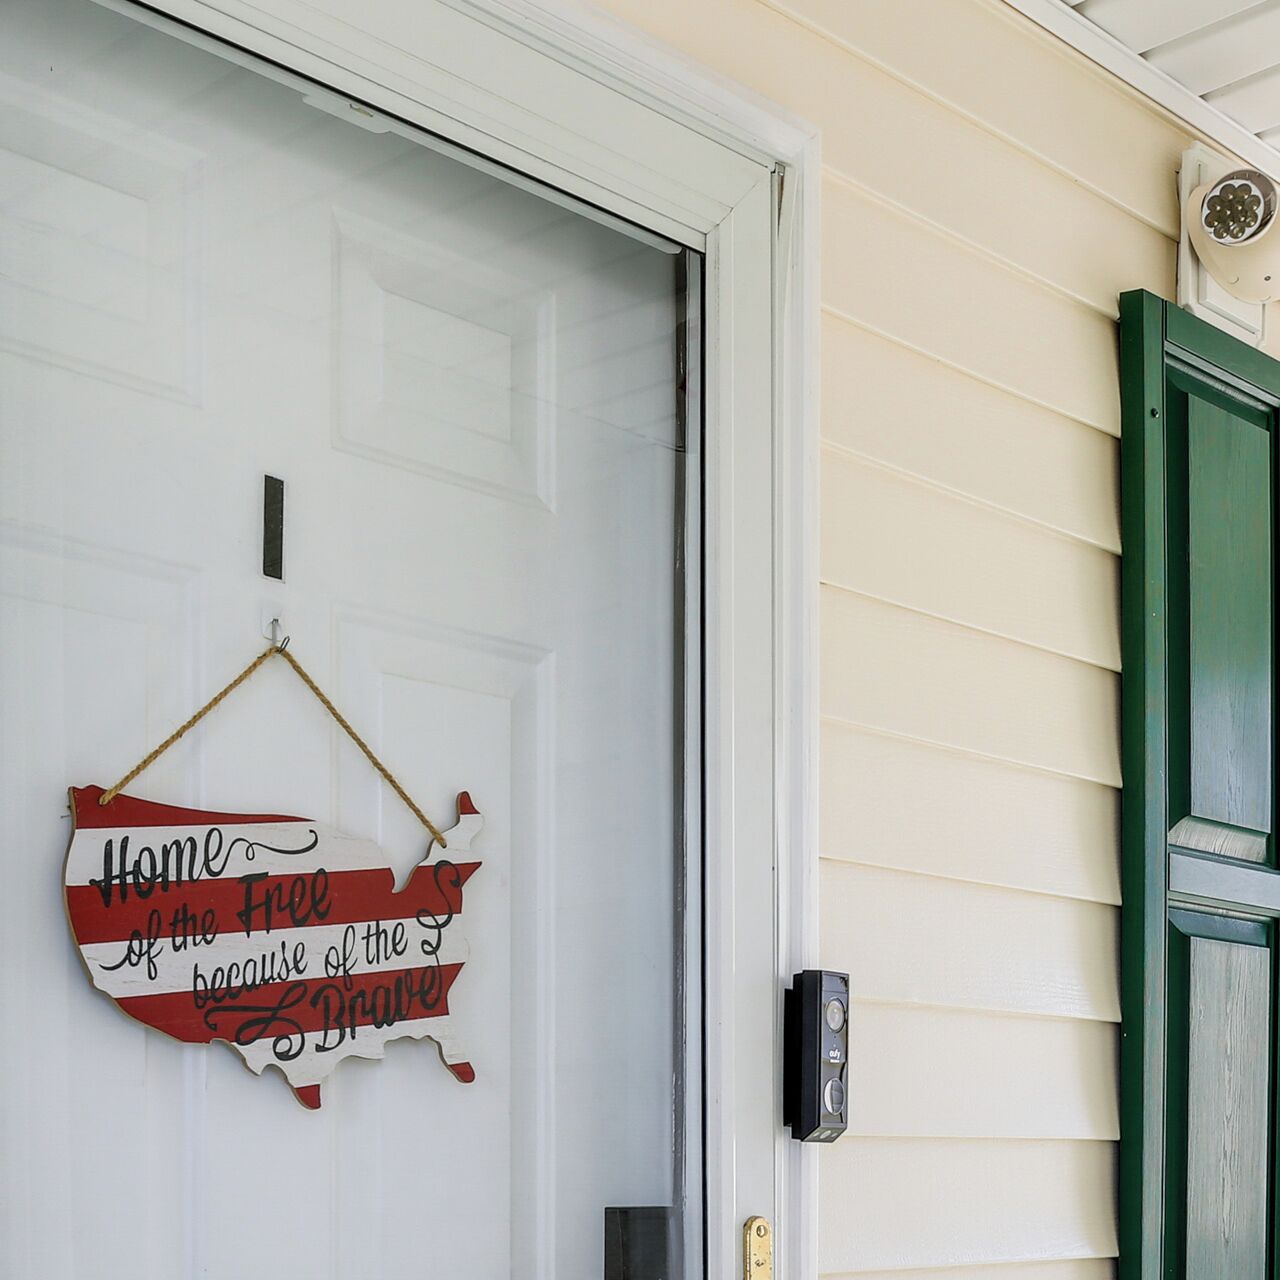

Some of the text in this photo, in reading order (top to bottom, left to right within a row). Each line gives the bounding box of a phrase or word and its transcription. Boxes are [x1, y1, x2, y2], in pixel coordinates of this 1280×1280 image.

[89, 827, 318, 907] Home
[99, 868, 332, 981] of the Free
[192, 919, 408, 1010] because of the
